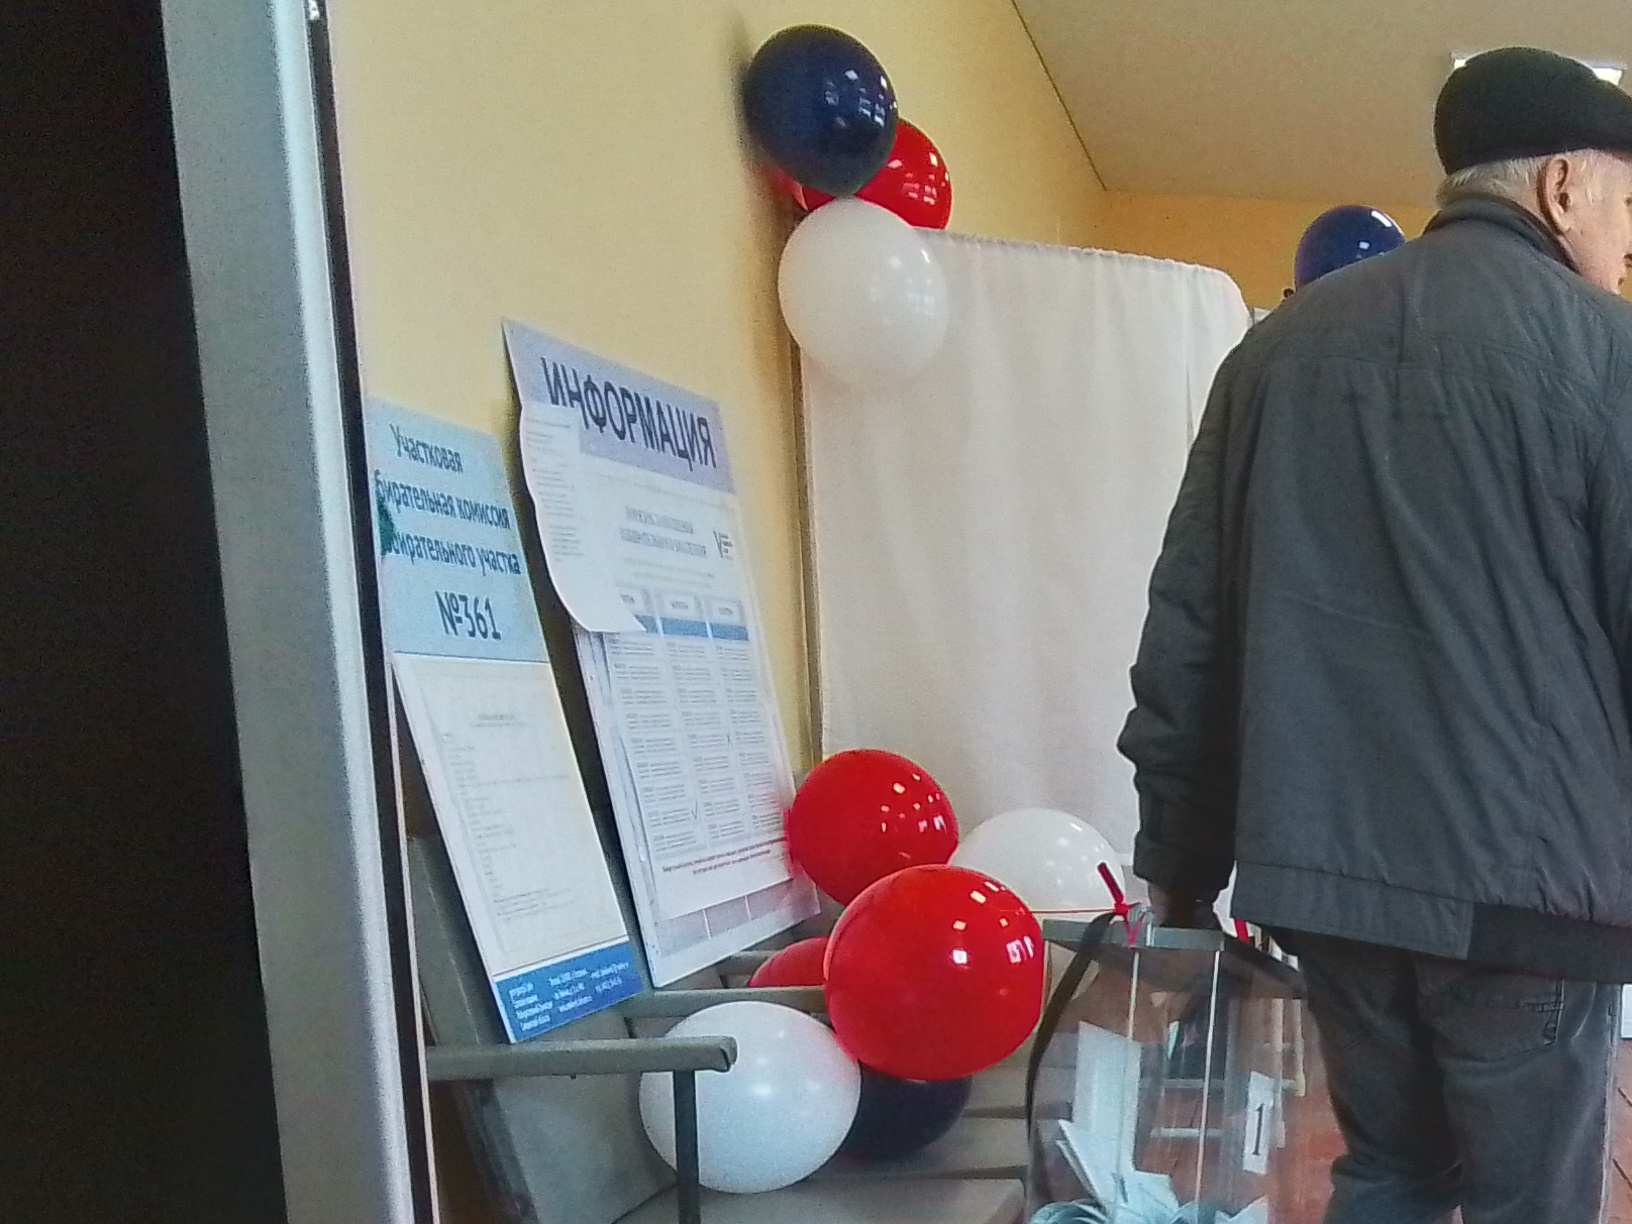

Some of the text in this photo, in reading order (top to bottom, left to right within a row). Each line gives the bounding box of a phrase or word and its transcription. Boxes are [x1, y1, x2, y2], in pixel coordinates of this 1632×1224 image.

[540, 356, 718, 472] ИНФОРМАЦИЯ
[389, 423, 464, 474] Участковая
[456, 496, 511, 530] комиссия
[477, 548, 522, 576] участка
[435, 590, 502, 641] №361
